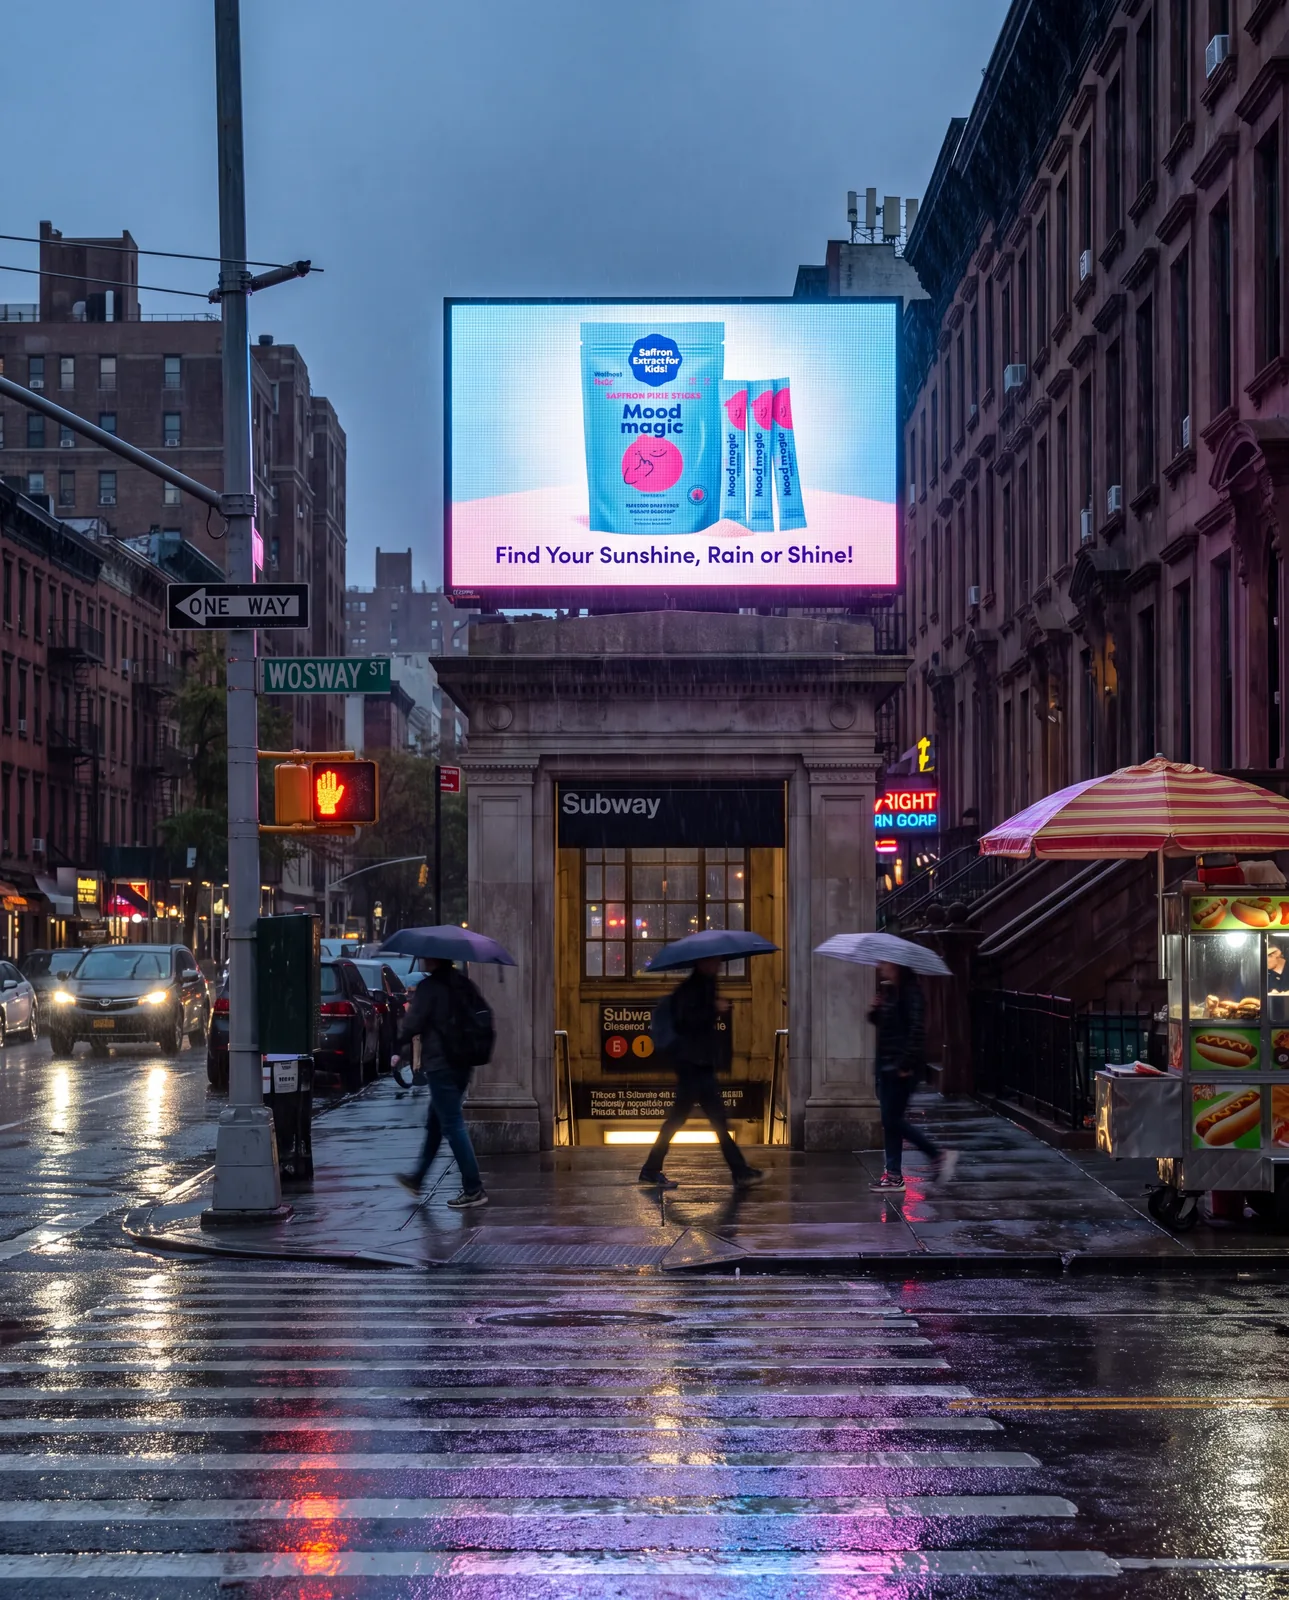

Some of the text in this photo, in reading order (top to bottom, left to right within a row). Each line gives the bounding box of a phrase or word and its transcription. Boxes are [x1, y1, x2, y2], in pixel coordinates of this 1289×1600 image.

[632, 356, 680, 365] Extract for
[639, 348, 673, 357] Saffron
[644, 365, 668, 373] Kids!
[622, 403, 682, 419] Mood
[621, 419, 684, 438] magic
[726, 468, 736, 497] Mood
[752, 468, 763, 497] Mood
[496, 545, 853, 567] Find Your Sunshine, Rain or Shine!
[189, 597, 291, 615] ONE WAY
[268, 661, 386, 689] WOSWAY ST
[562, 792, 661, 819] Subway
